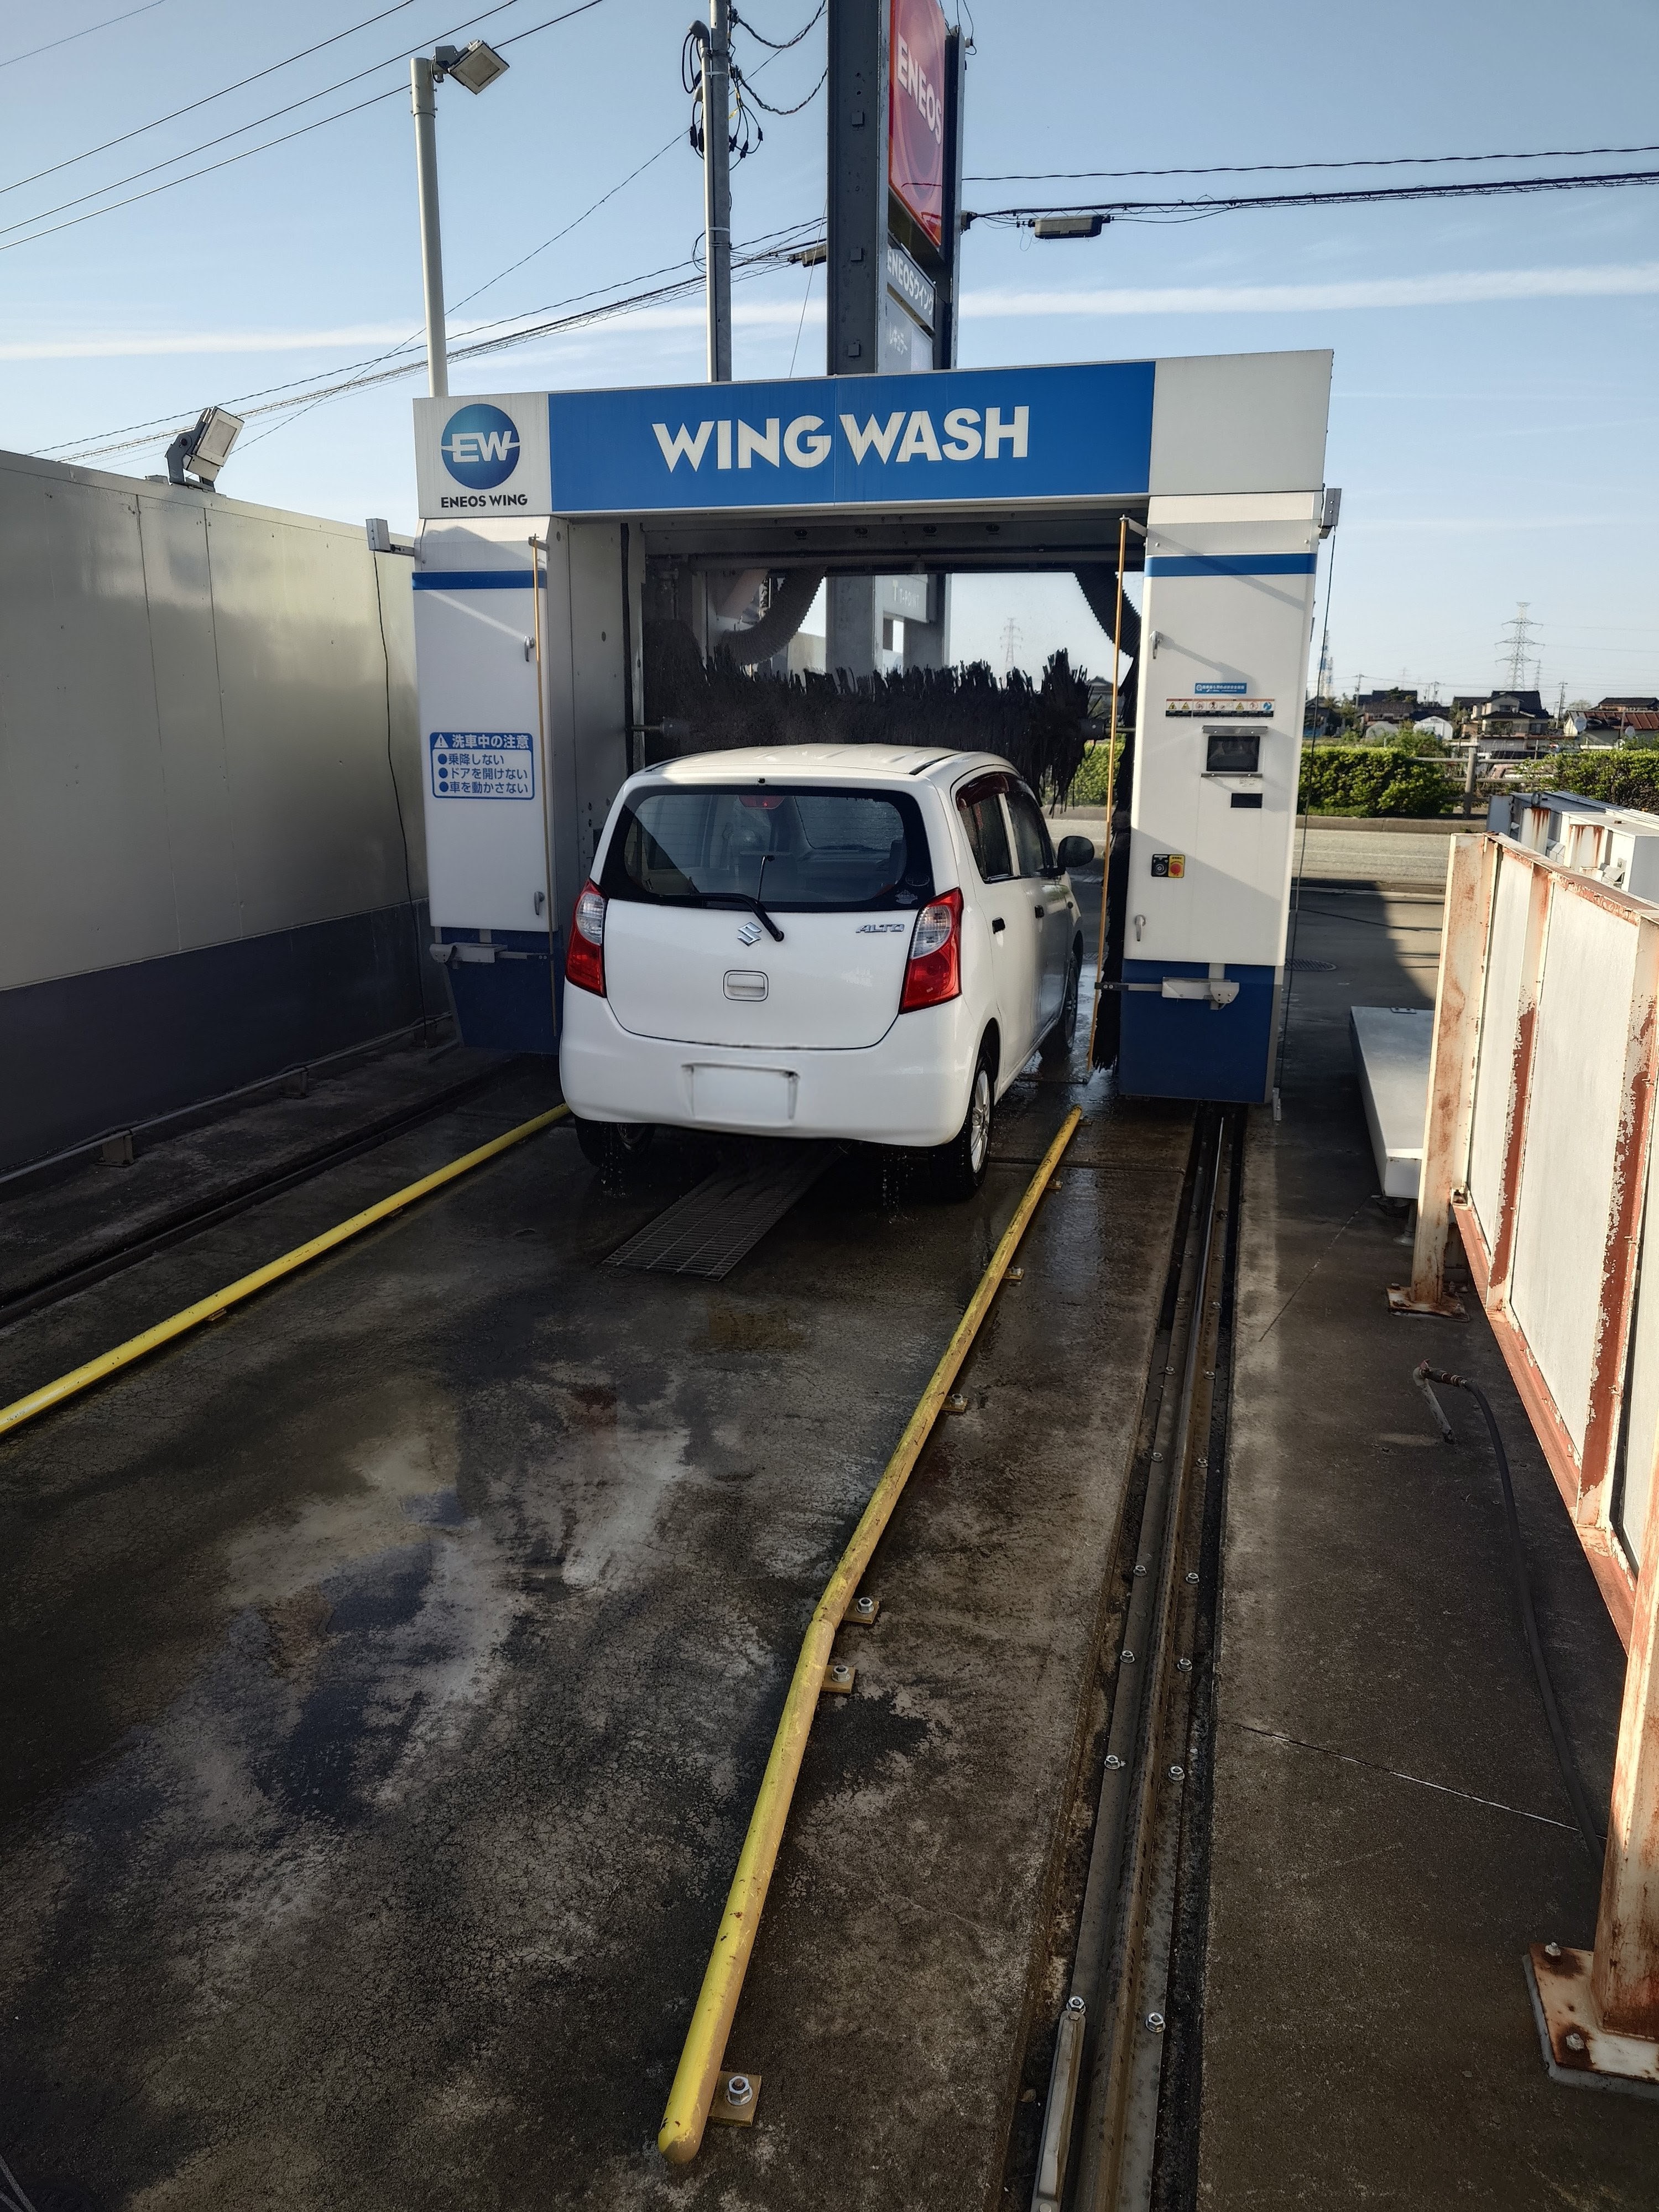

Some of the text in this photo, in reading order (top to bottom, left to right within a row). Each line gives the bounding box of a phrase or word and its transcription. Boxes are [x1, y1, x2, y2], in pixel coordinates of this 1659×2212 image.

[898, 32, 942, 144] ENEOS
[652, 405, 1030, 473] WING WASH
[452, 430, 512, 463] EW
[441, 494, 528, 508] ENEOS WING
[452, 734, 529, 749] 洗車中の注意
[448, 753, 504, 765] 乗降しない
[451, 768, 528, 780] ドアを開けない
[450, 781, 528, 794] 車を動かさない
[855, 924, 905, 933] ALTO
